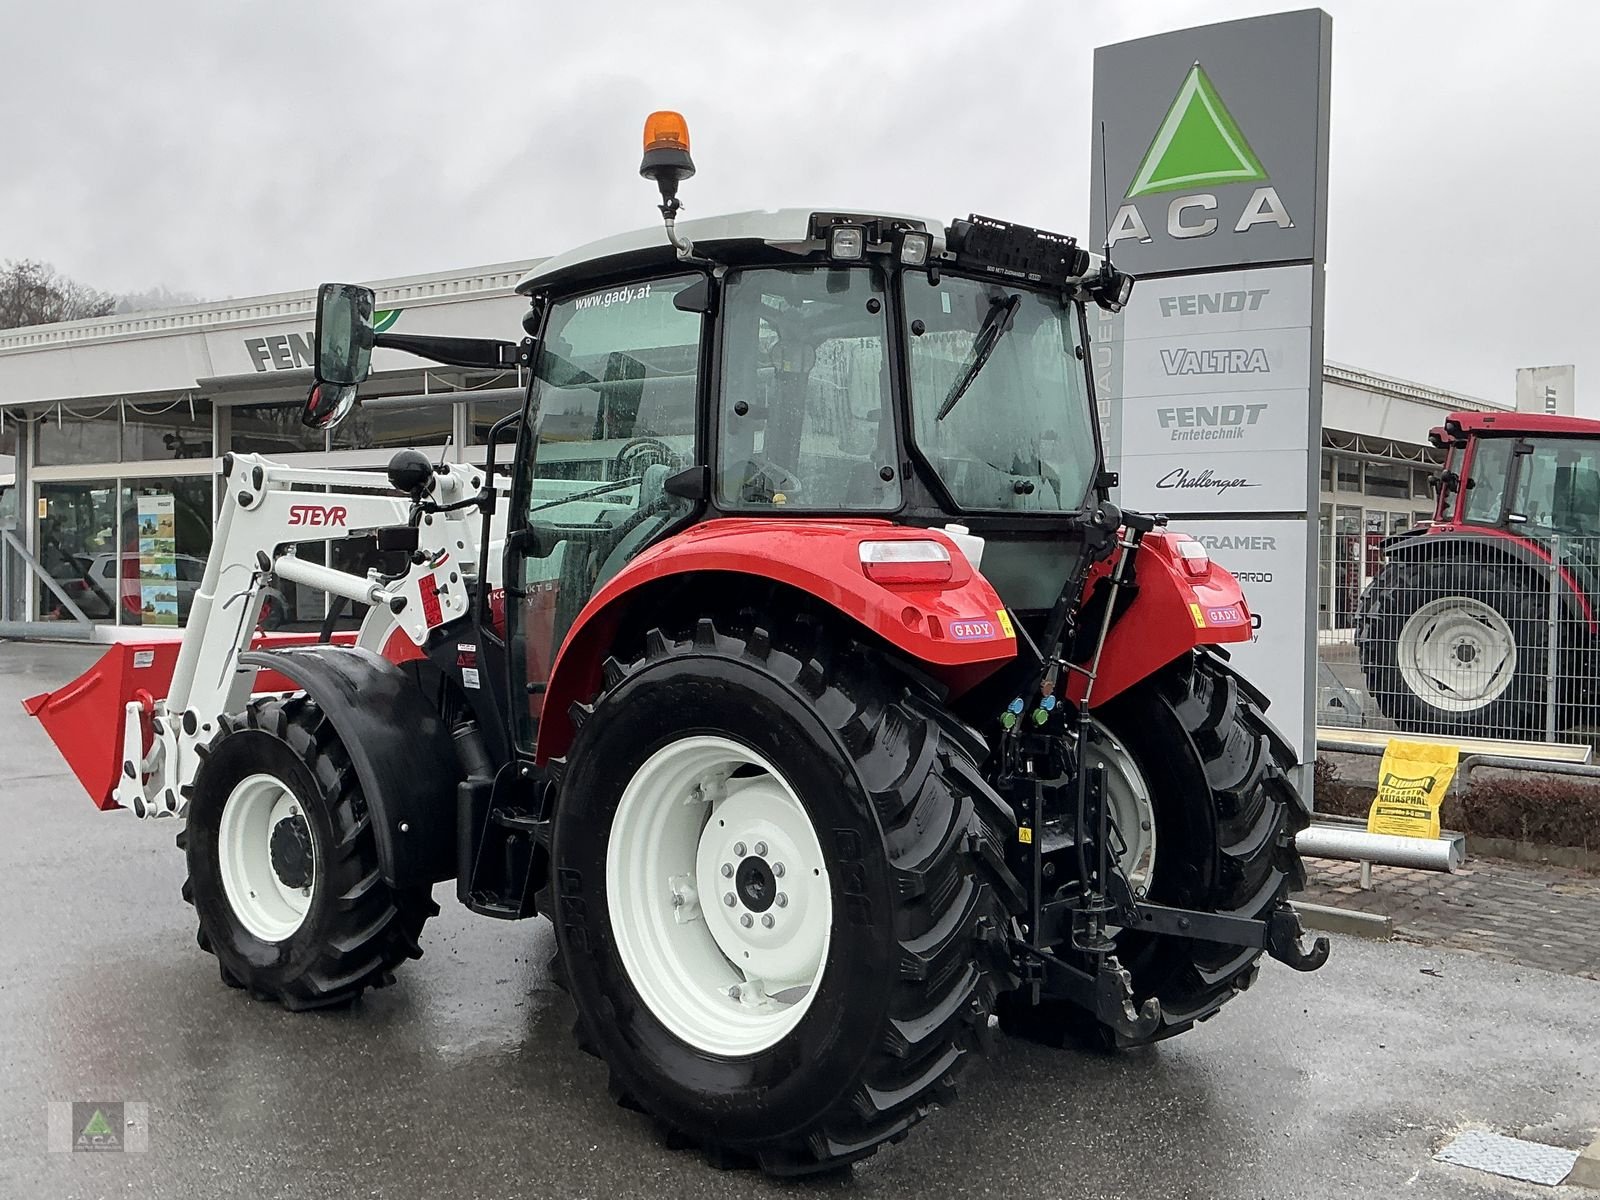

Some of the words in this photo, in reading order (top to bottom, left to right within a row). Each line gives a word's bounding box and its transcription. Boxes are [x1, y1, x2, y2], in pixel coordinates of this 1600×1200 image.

[1102, 186, 1295, 248] ACA
[575, 284, 651, 310] www.gady.at
[1159, 289, 1271, 317] FENDT
[244, 332, 315, 372] FEN
[1160, 349, 1270, 375] VALTRA
[1157, 404, 1268, 428] FENDT
[1171, 427, 1244, 441] Erntetechnik
[1155, 468, 1262, 495] Challenger
[288, 505, 347, 526] STEYR
[1231, 571, 1273, 583] PARDO
[1210, 610, 1237, 621] GADY
[955, 623, 989, 636] GADY
